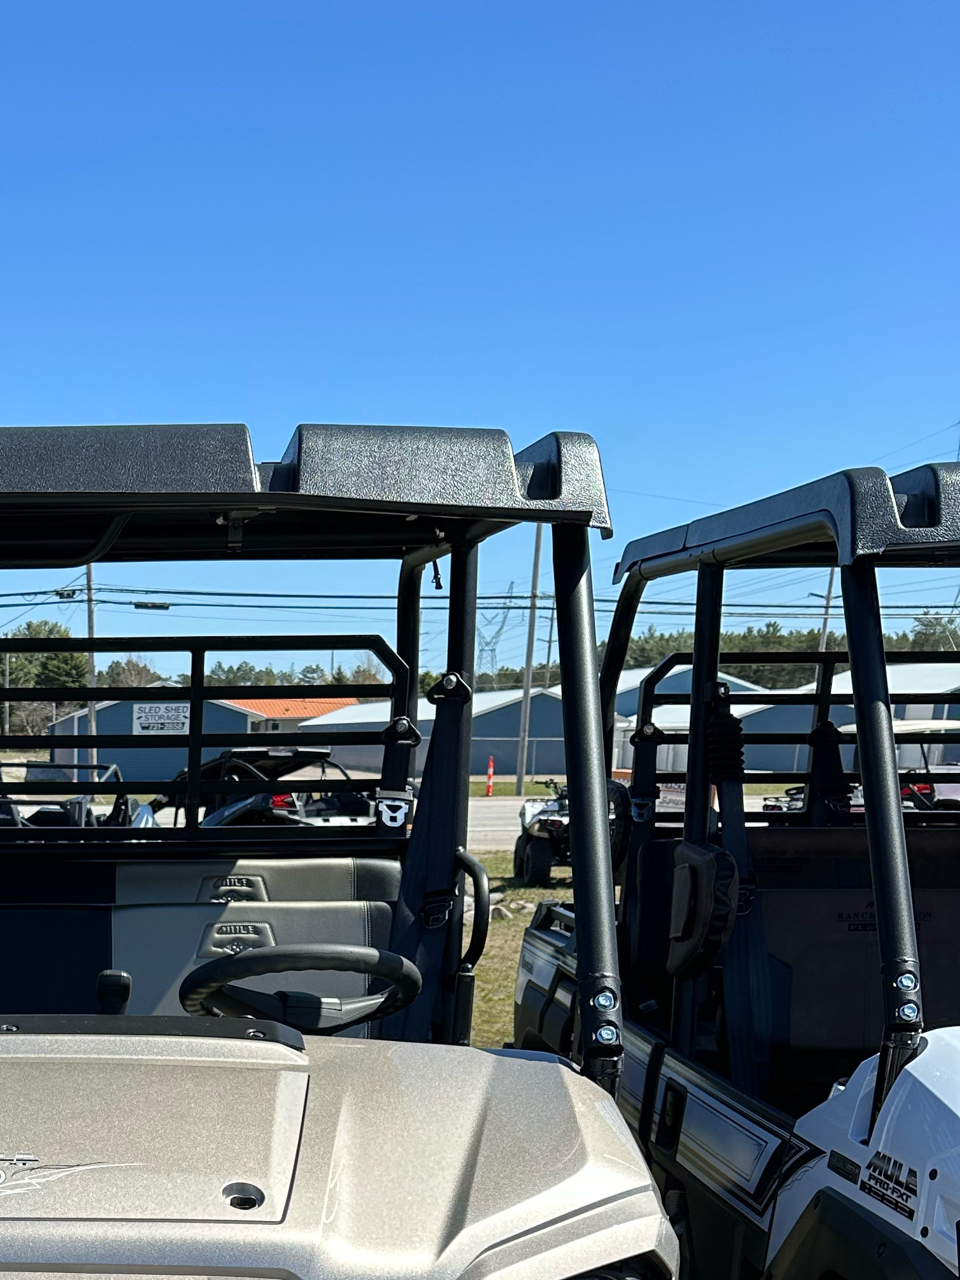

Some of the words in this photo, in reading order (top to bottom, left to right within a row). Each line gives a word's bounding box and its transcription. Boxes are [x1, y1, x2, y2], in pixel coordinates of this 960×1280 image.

[137, 706, 161, 714] SLED
[164, 705, 189, 714] SHED
[865, 1150, 918, 1197] MULE
